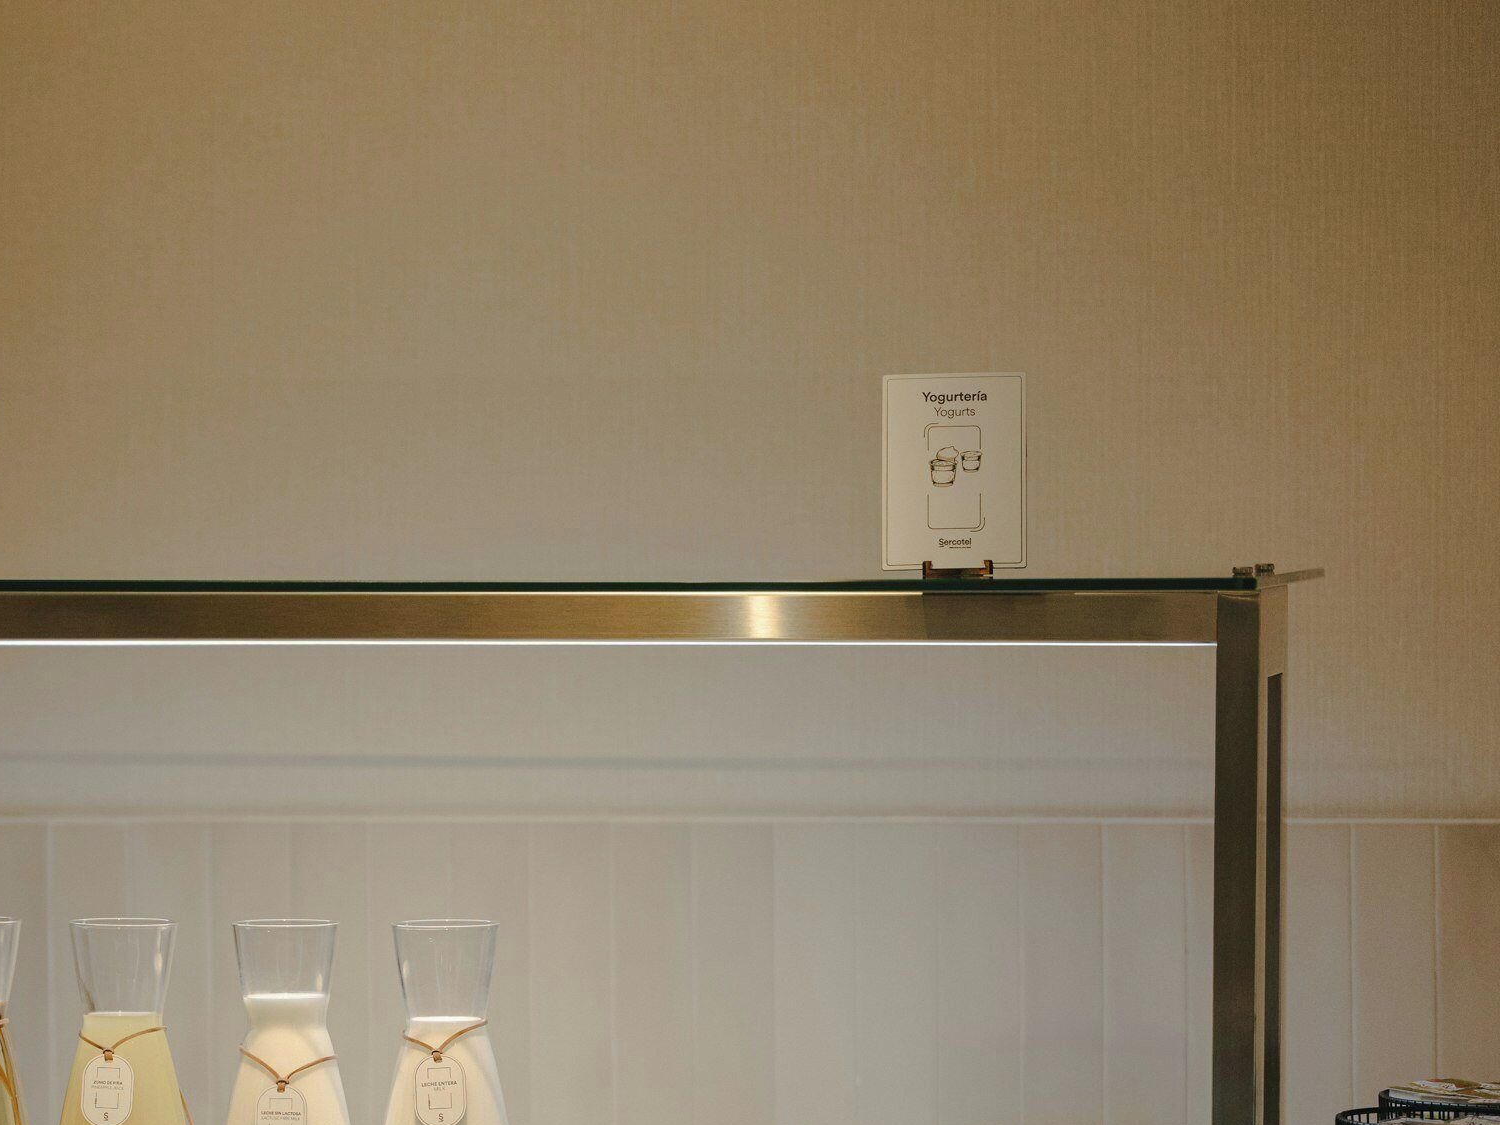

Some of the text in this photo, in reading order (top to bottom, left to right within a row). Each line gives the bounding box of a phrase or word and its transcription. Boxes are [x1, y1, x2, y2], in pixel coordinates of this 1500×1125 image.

[922, 390, 988, 405] Yogurtería
[934, 407, 976, 419] Yogurts
[938, 537, 972, 547] Sercotel
